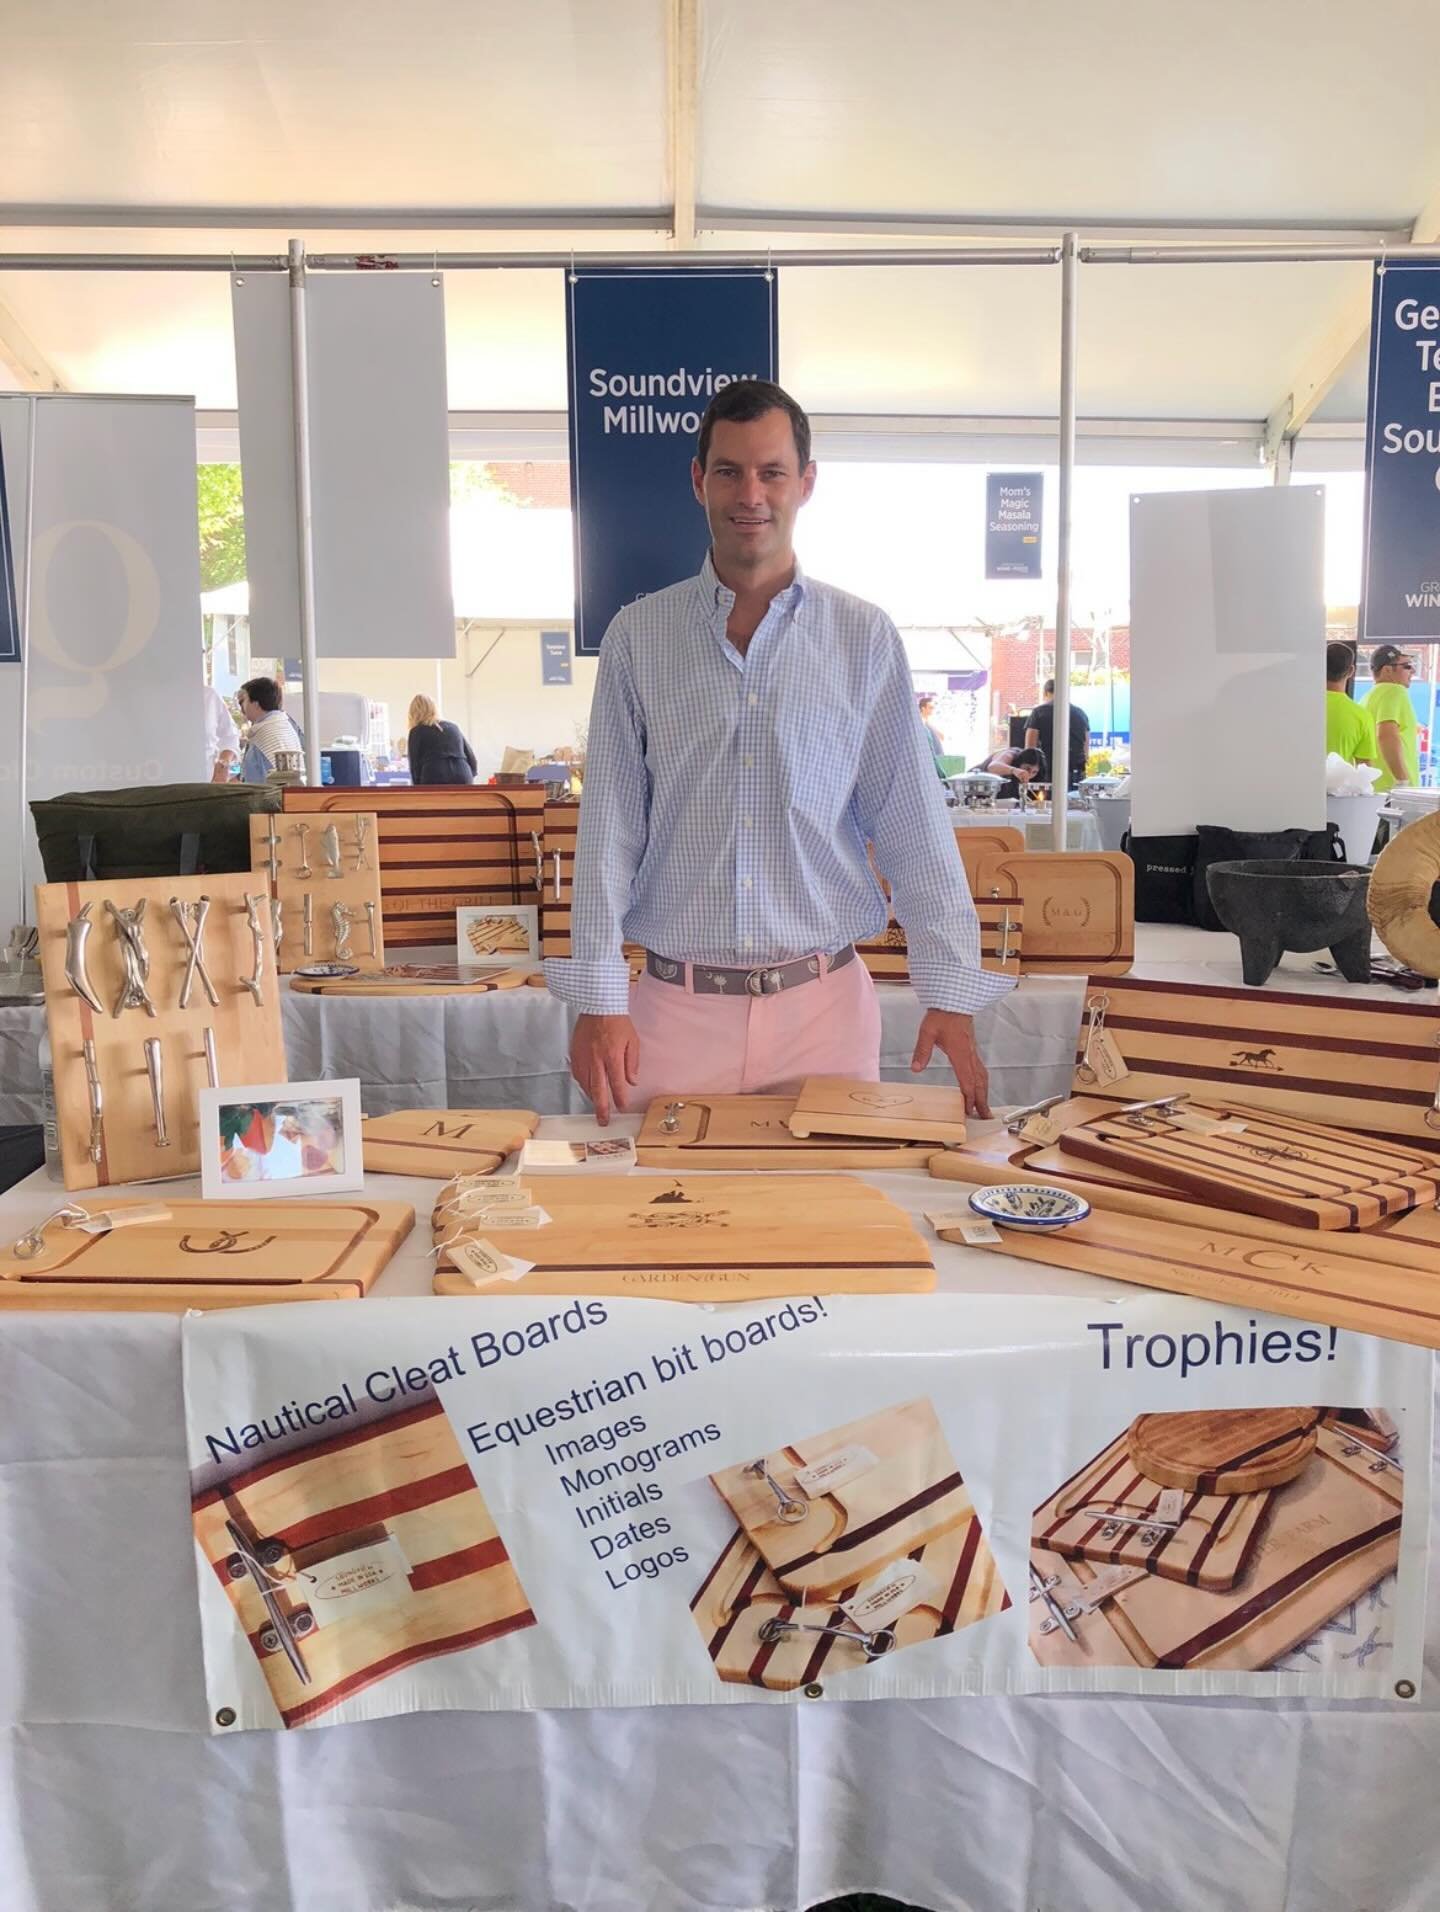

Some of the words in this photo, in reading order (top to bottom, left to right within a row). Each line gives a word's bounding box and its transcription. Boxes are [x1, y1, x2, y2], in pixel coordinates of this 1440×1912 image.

[1395, 299, 1440, 330] Ge
[603, 405, 704, 434] Millwo
[1000, 486, 1031, 497] Mom's
[1001, 498, 1030, 511] Magic
[989, 521, 1039, 533] Seasoning
[998, 510, 1031, 520] Masala
[1087, 1321, 1338, 1377] Trophies!
[205, 1384, 357, 1465] Nautical
[364, 1346, 466, 1404] Cleat
[470, 1300, 608, 1369] Boards
[467, 1369, 647, 1455] Equestrian
[652, 1343, 698, 1384] bit
[700, 1296, 828, 1363] boards!
[545, 1412, 647, 1466] Images
[560, 1421, 722, 1497] Monograms
[576, 1481, 664, 1529] Initials
[591, 1516, 672, 1561] Dates
[606, 1543, 690, 1590] Logos
